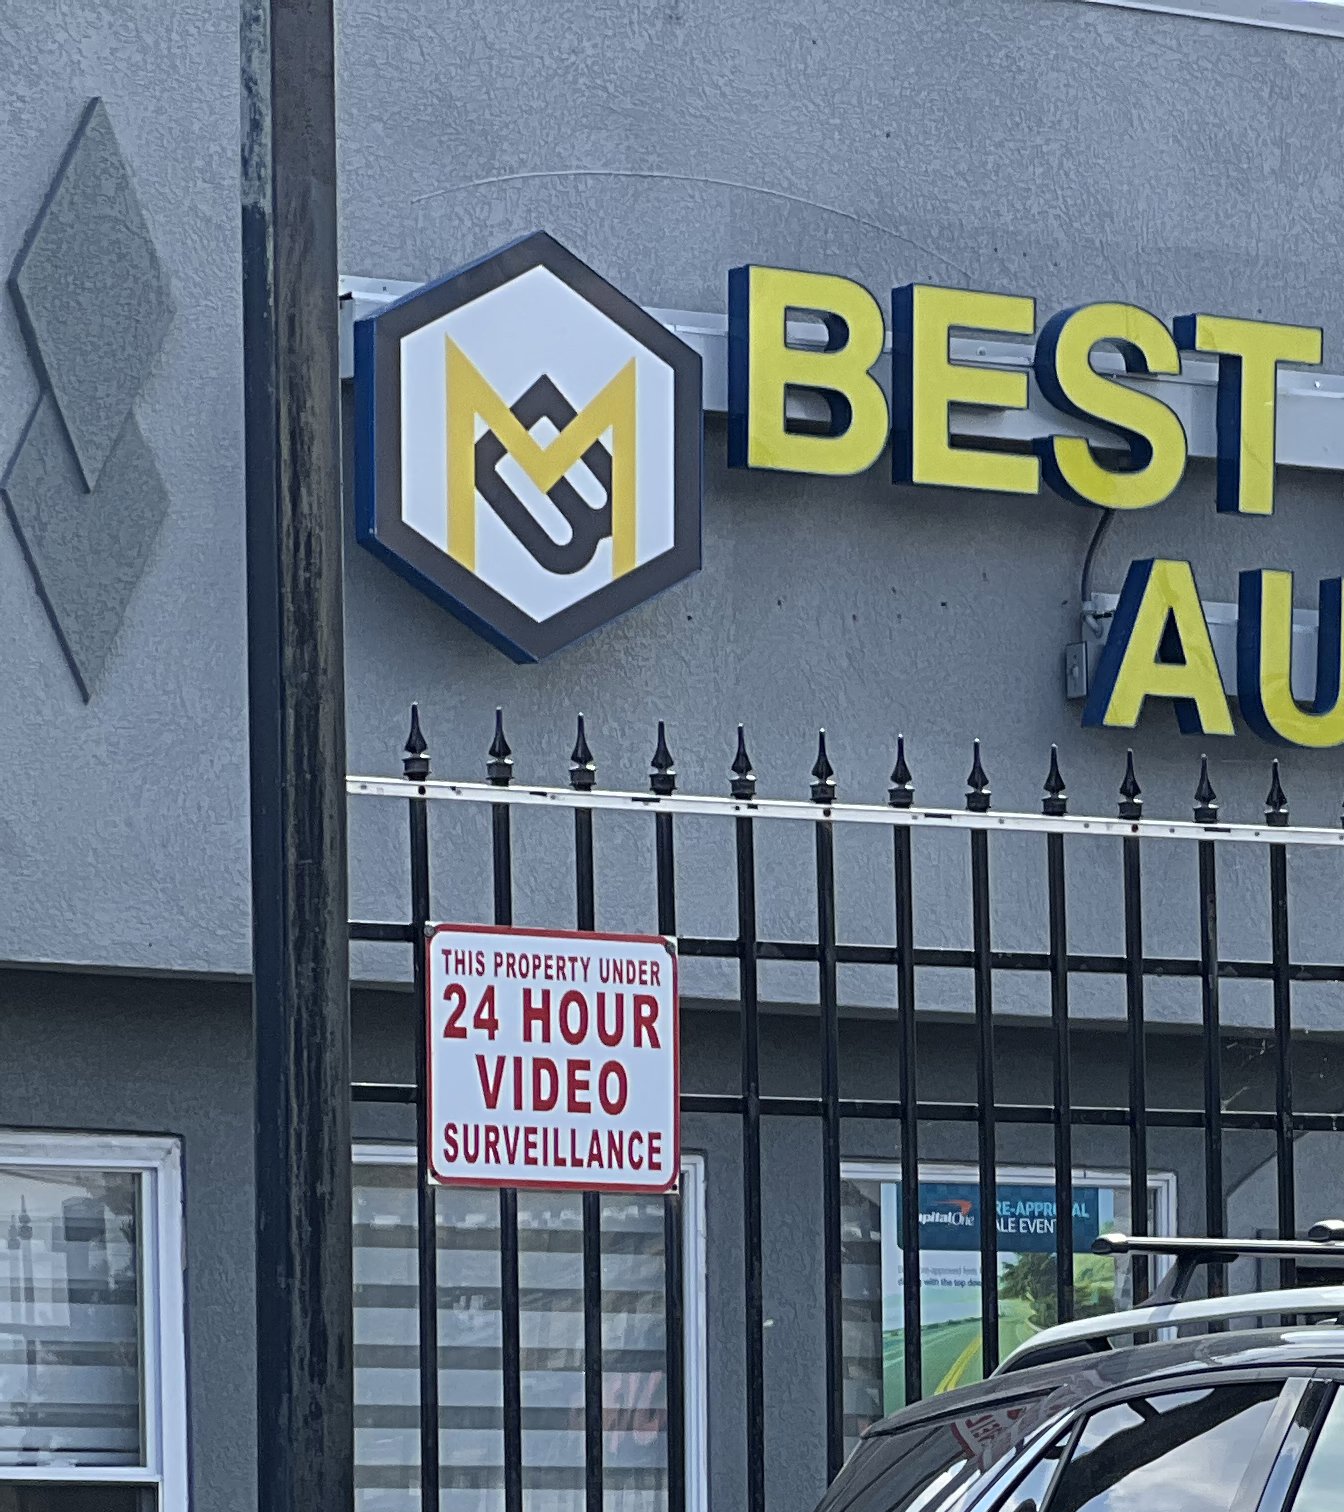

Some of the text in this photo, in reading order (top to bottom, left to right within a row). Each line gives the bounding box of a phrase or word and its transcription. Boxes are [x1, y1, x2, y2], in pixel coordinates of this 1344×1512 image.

[728, 263, 1323, 516] BEST
[441, 949, 661, 986] THIS PROPERTY UNDER
[443, 983, 661, 1049] 24 HOUR
[475, 1054, 628, 1115] VIDEO
[443, 1122, 662, 1171] SURVEILLANCE
